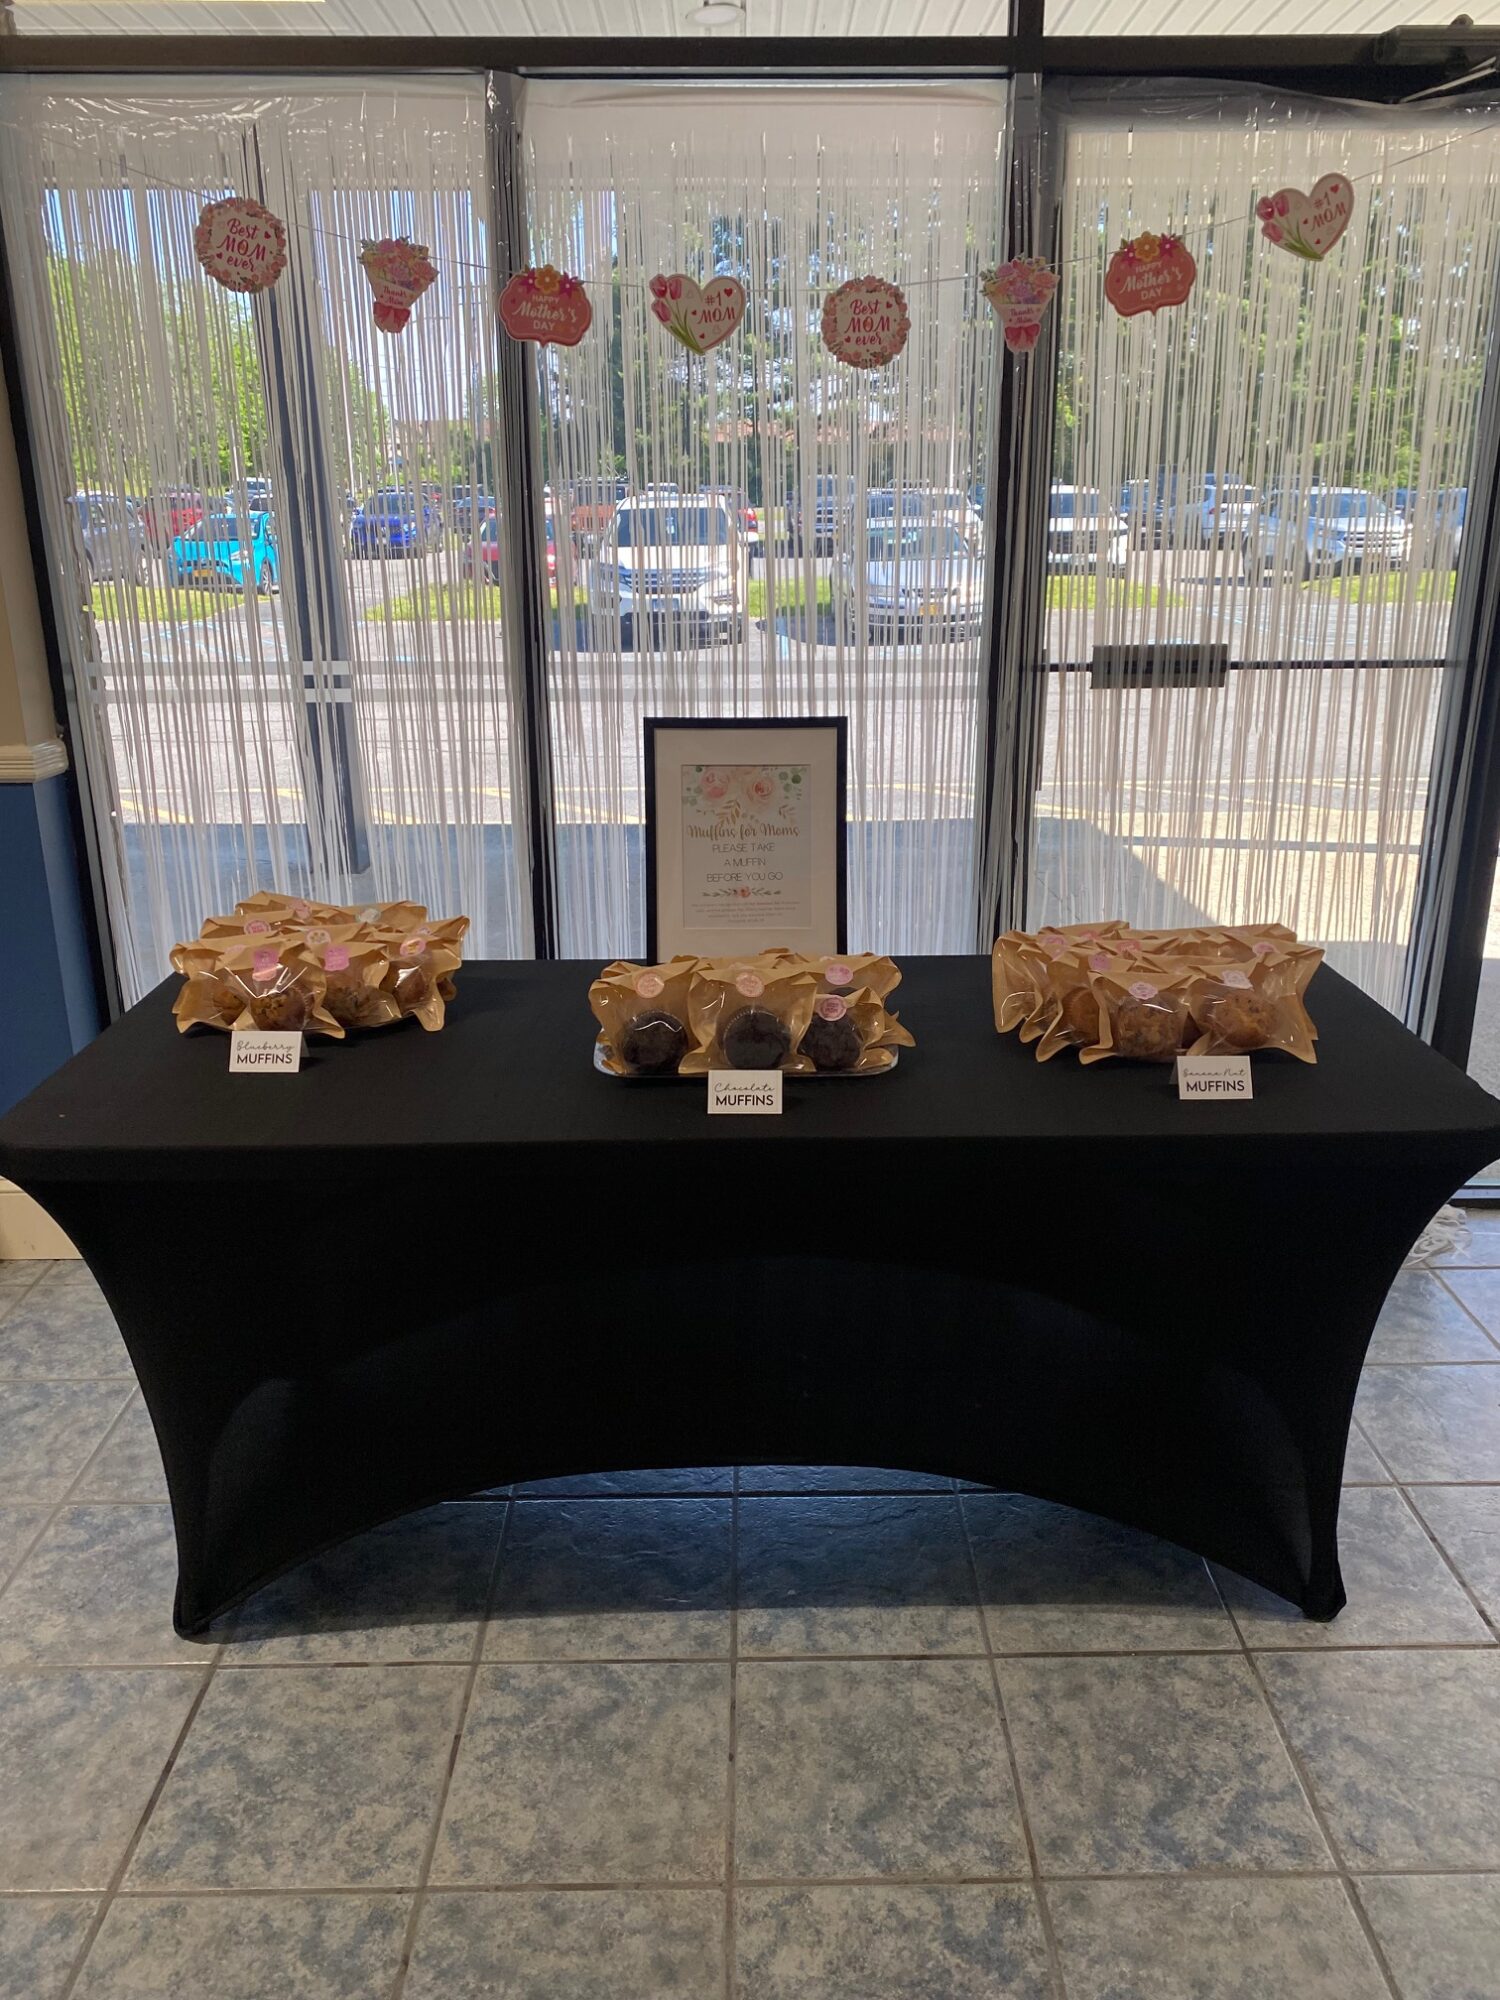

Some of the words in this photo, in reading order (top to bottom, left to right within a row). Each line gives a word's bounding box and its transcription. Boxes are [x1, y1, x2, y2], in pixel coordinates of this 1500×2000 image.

[1312, 192, 1331, 211] #1
[1310, 202, 1346, 232] MOM
[226, 217, 260, 240] Best
[216, 235, 266, 262] MOM
[226, 256, 256, 272] ever
[1135, 261, 1162, 273] HAPPY
[1119, 266, 1184, 295] Mother's
[531, 294, 560, 305] HAPPY
[704, 291, 722, 306] #1
[1140, 286, 1162, 300] DAY
[512, 301, 577, 323] Mother's
[850, 299, 880, 315] Best
[697, 307, 736, 324] MOM
[533, 320, 555, 331] DAY
[844, 316, 890, 333] MOM
[855, 334, 882, 346] ever
[688, 824, 736, 841] Muffins
[740, 823, 757, 840] for
[761, 823, 800, 837] Moms
[712, 843, 747, 853] PLEASE
[751, 842, 775, 852] TAKE
[723, 859, 731, 867] A
[733, 858, 766, 867] MUFFIN
[706, 873, 742, 882] BEFORE
[745, 872, 765, 881] YOU
[768, 872, 784, 881] GO
[236, 1040, 295, 1054] Blueberry
[236, 1053, 293, 1064] MUFFINS
[714, 1082, 775, 1093] Chocolate
[1186, 1080, 1245, 1092] MUFFINS
[715, 1094, 774, 1106] MUFFINS
